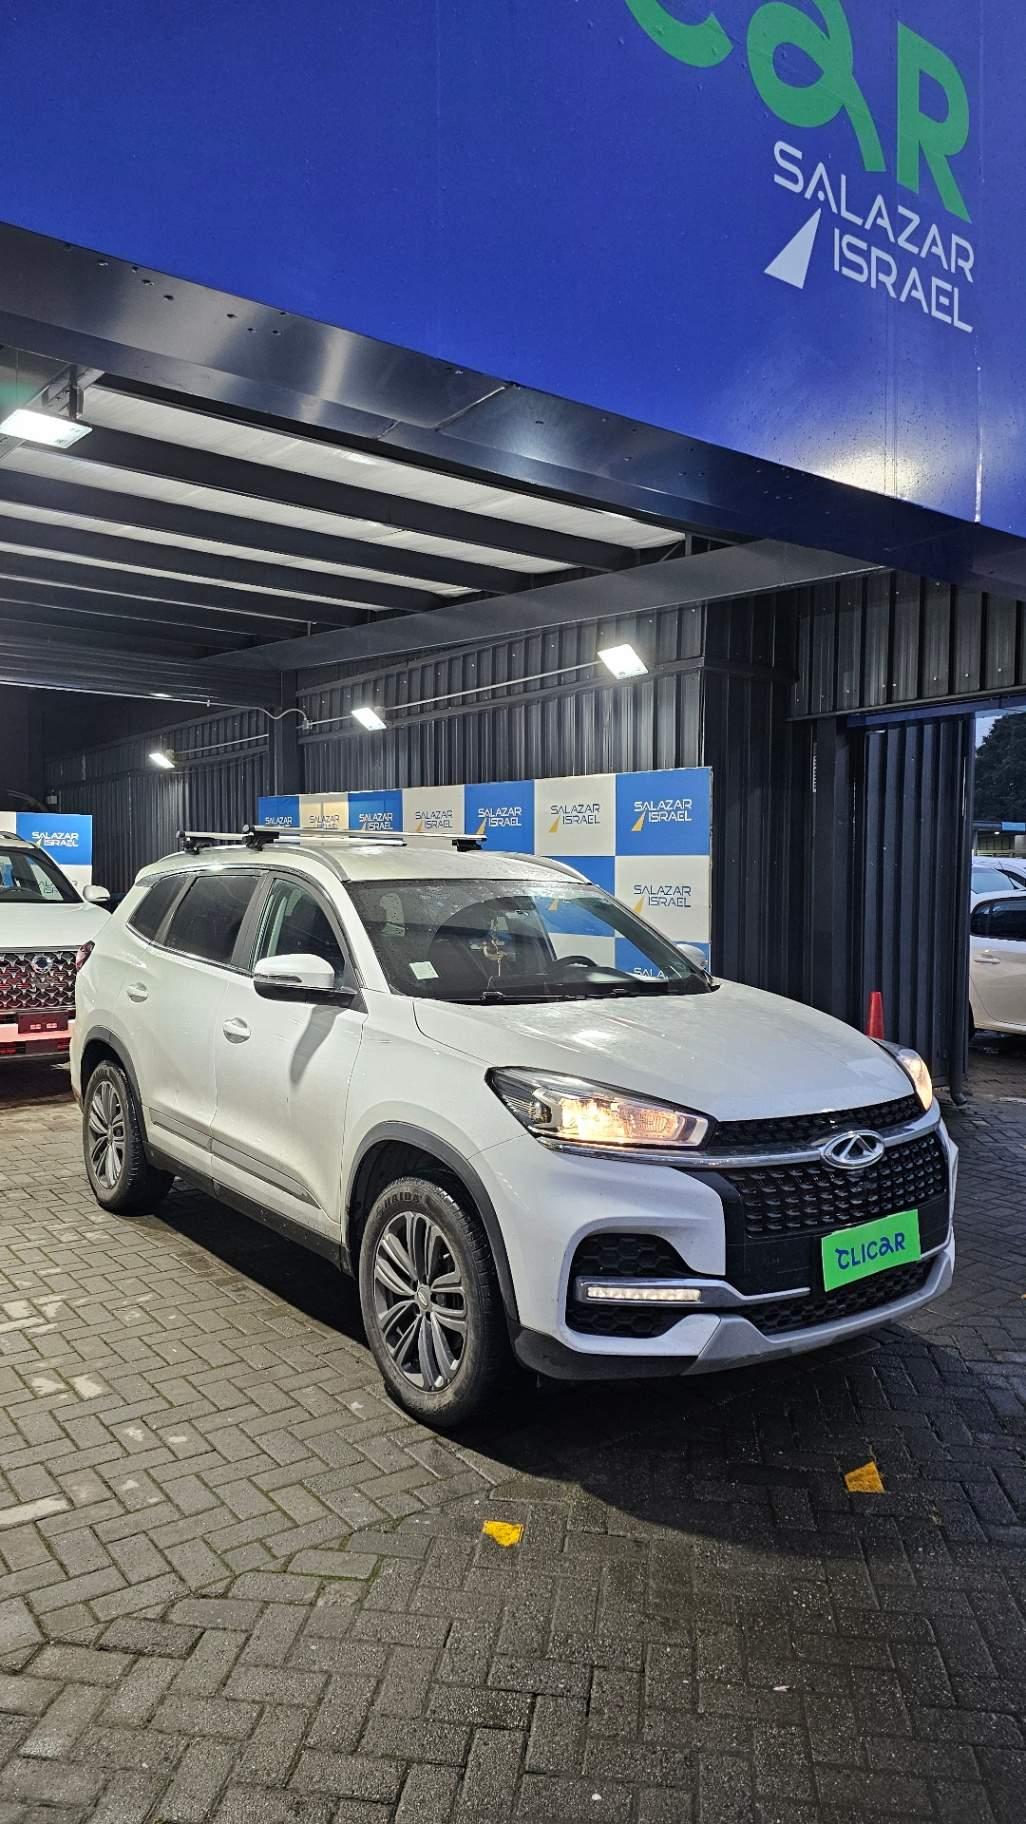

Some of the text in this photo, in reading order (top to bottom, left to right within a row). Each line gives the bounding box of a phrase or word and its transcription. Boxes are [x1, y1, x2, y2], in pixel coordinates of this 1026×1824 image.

[774, 141, 975, 283] SALAZAR
[834, 228, 974, 333] ISRAEL
[550, 803, 601, 815] SALAZAR
[633, 799, 693, 812] SALAZAR
[359, 812, 394, 823] SALAZAR
[415, 809, 454, 820] SALAZAR
[477, 806, 523, 818] SALAZAR
[648, 810, 693, 823] ISRAEL
[264, 816, 293, 825] SALAZAR
[308, 814, 341, 824] SALAZAR
[424, 819, 454, 829] ISRAEL
[488, 817, 523, 827] ISRAEL
[562, 814, 601, 825] ISRAEL
[367, 821, 394, 831] ISRAEL
[32, 831, 79, 841] SALAZAR
[43, 838, 79, 848] ISRAEL
[633, 884, 692, 897] SALAZAR
[648, 895, 692, 908] ISRAEL
